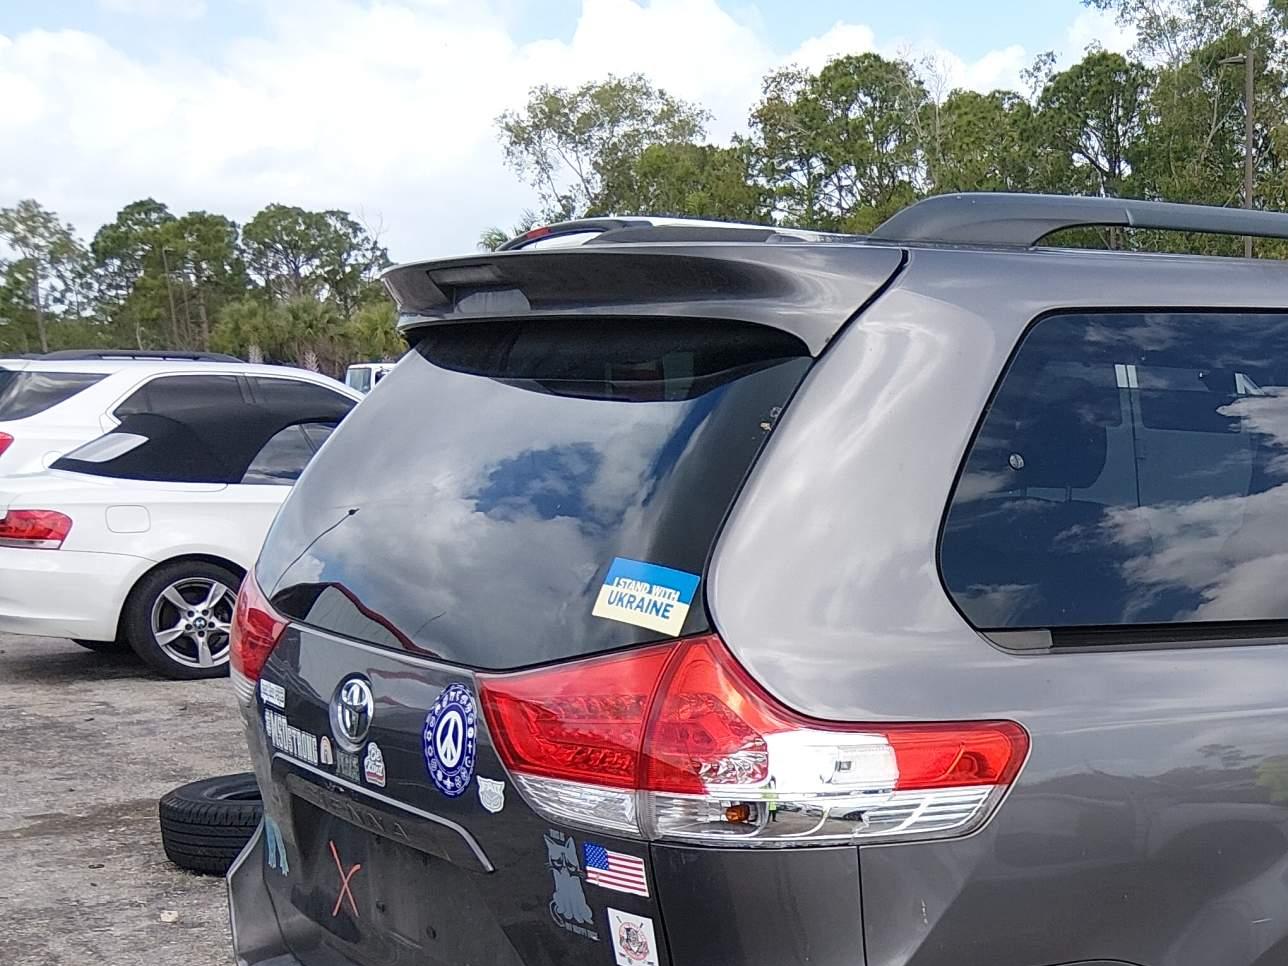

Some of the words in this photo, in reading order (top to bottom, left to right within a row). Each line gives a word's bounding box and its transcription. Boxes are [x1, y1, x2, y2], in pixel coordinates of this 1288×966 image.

[618, 578, 650, 594] STAND
[652, 584, 681, 602] WITH
[607, 590, 674, 619] UKRAINE
